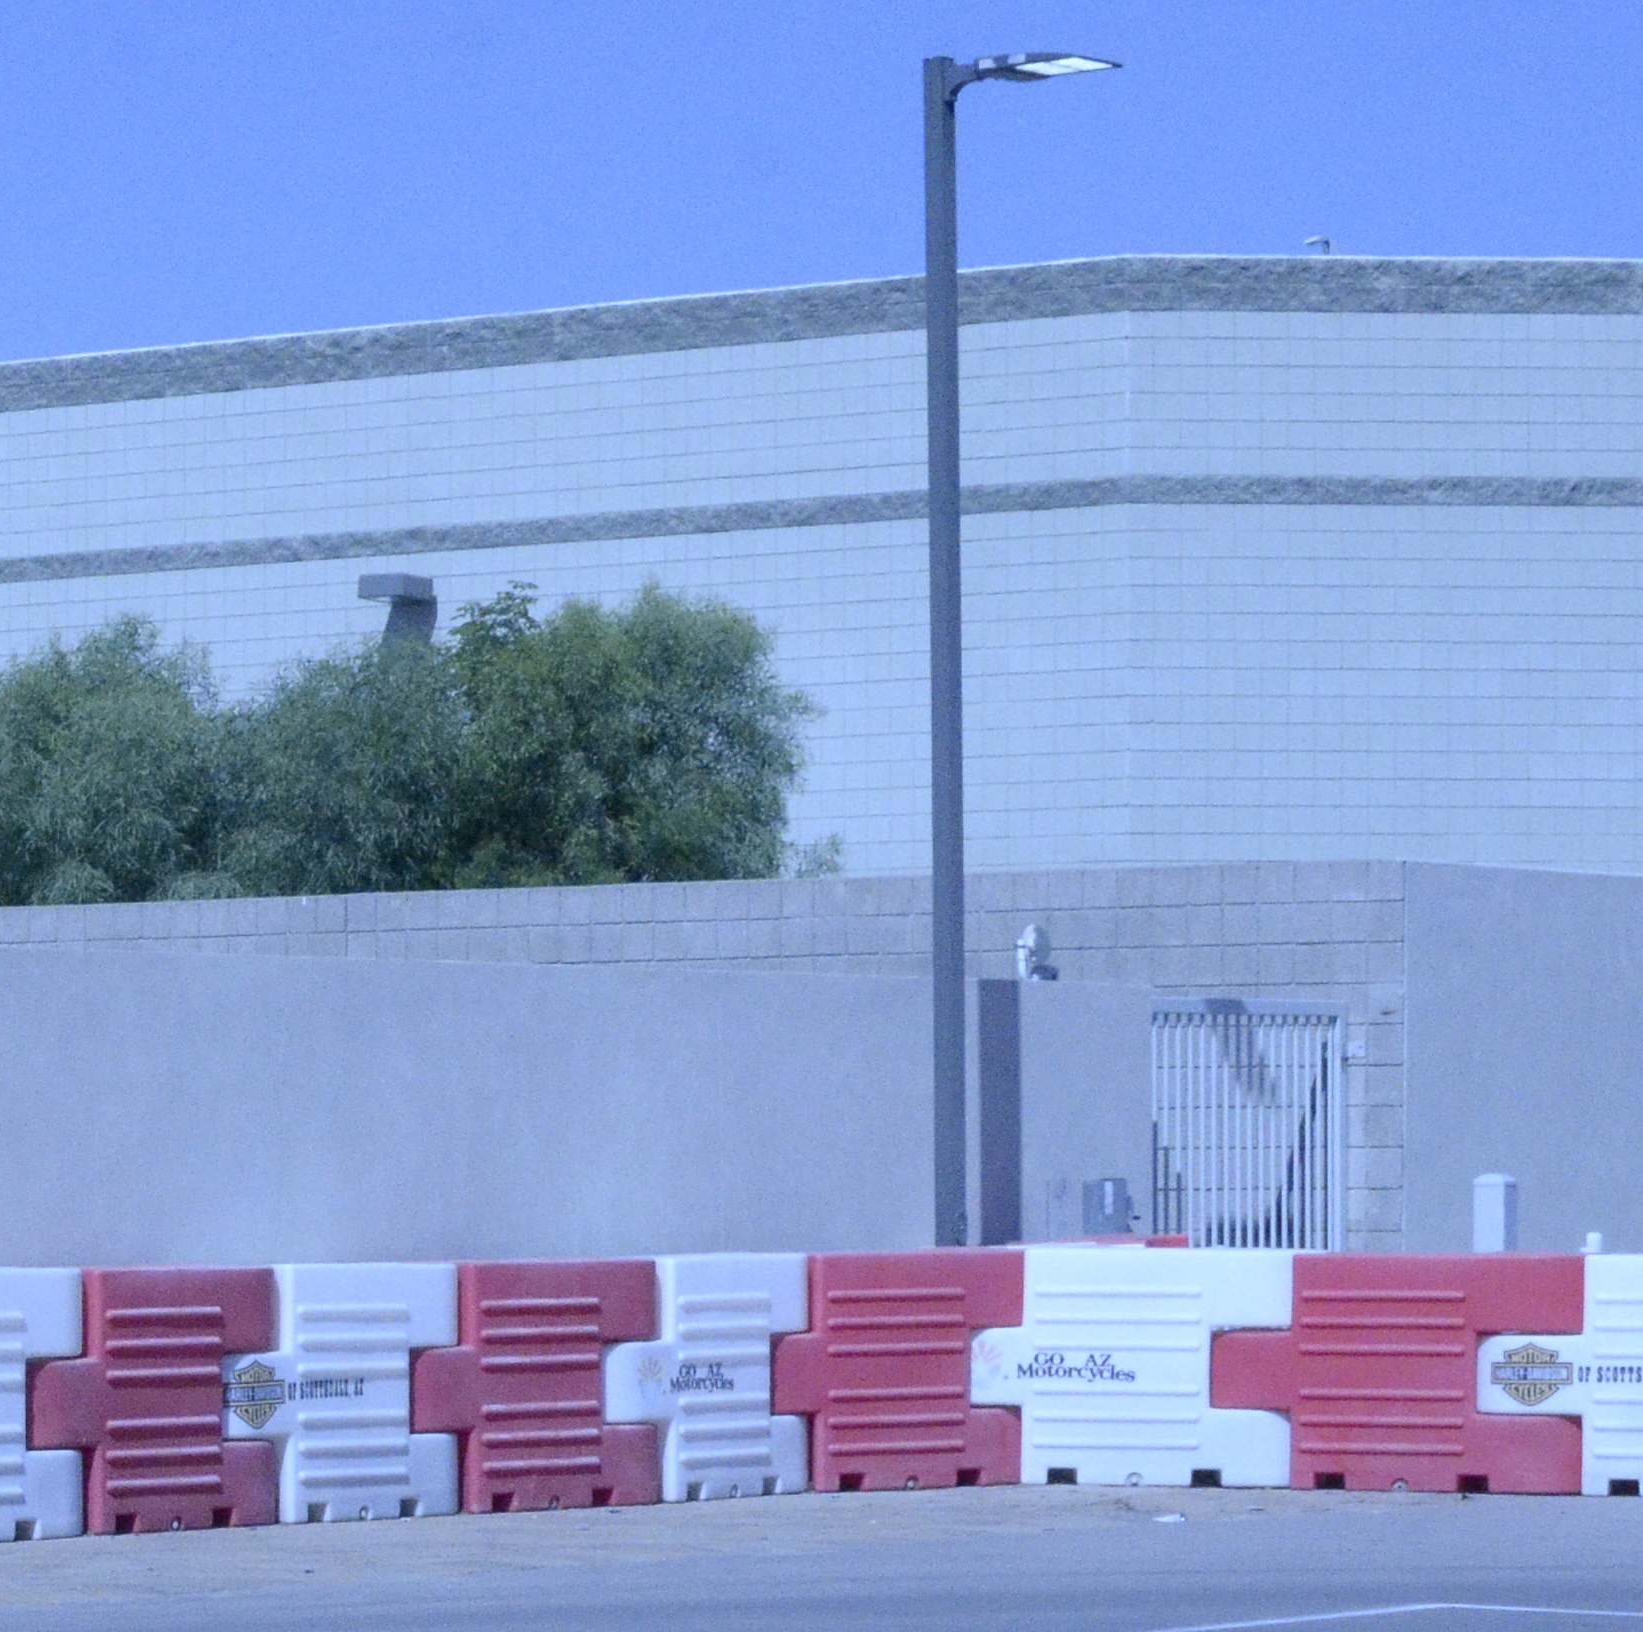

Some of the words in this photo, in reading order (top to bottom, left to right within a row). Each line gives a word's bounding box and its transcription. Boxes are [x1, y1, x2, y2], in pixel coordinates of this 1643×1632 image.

[1034, 1352, 1064, 1366] GO
[1085, 1354, 1112, 1367] AZ
[679, 1364, 696, 1378] GO
[1017, 1363, 1135, 1382] Motorcycles
[1578, 1366, 1591, 1383] OF
